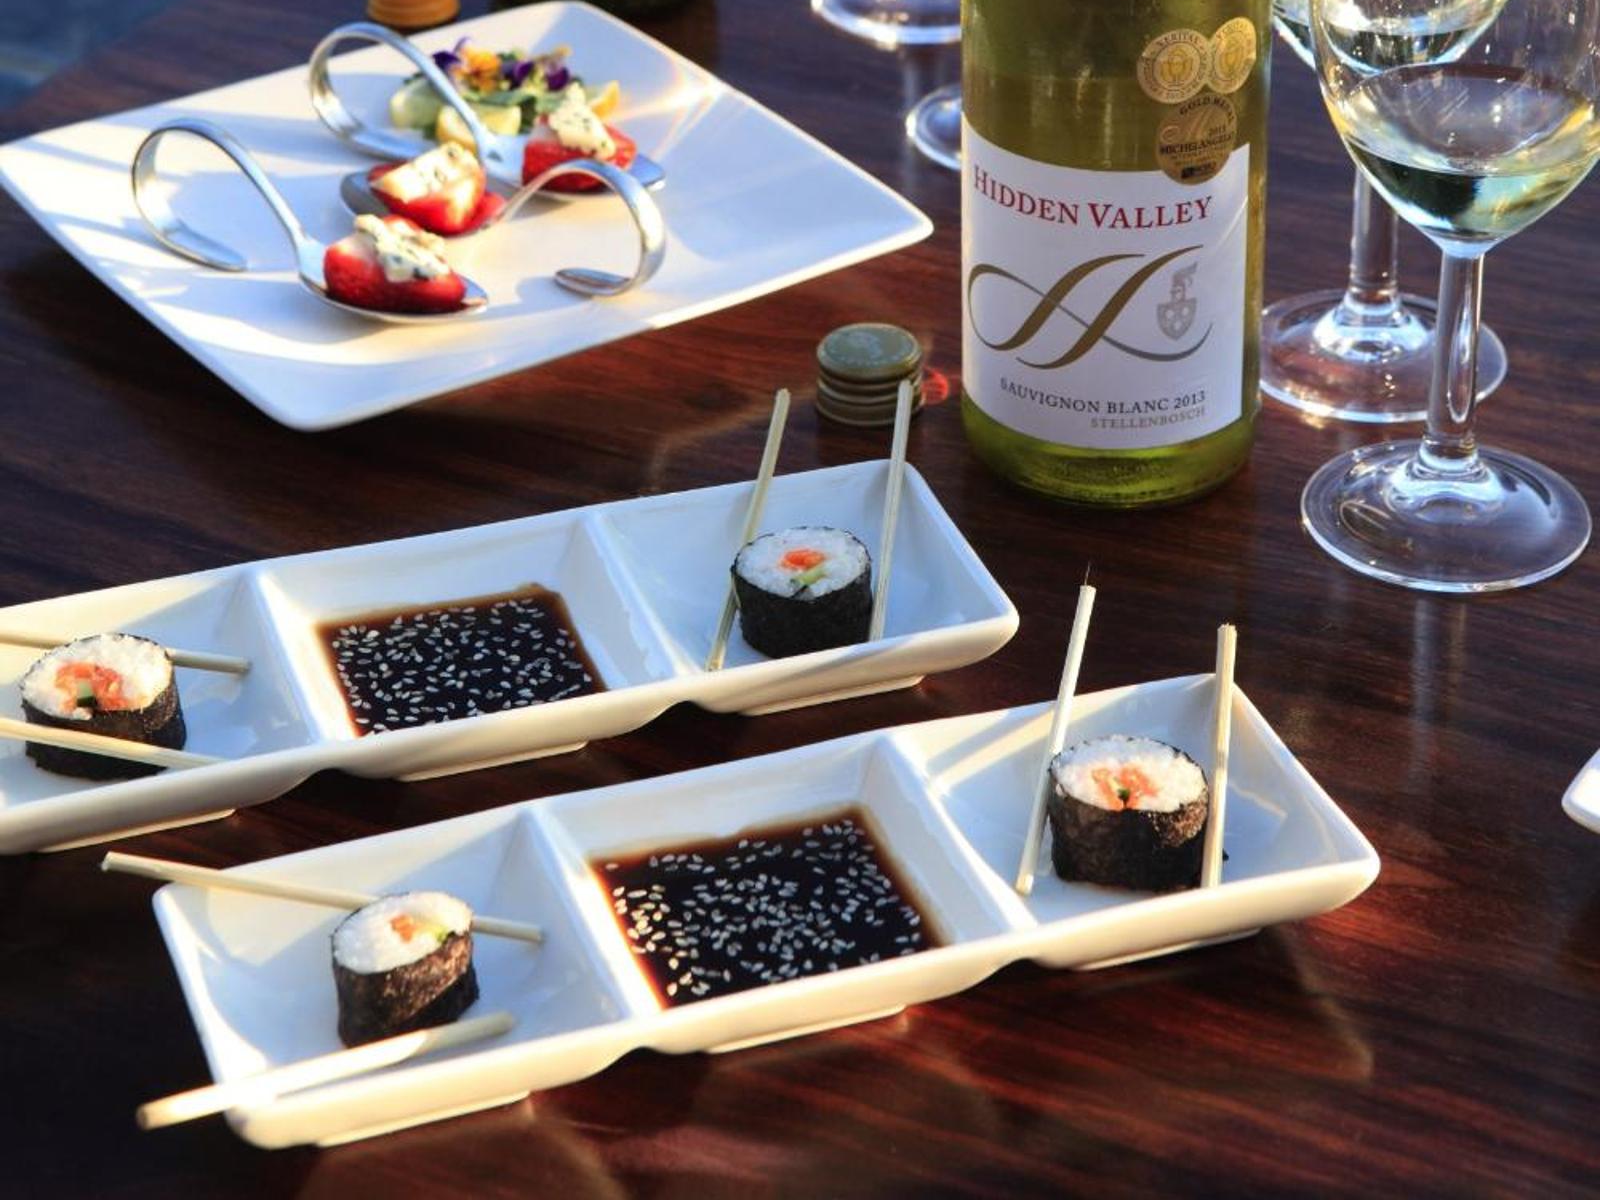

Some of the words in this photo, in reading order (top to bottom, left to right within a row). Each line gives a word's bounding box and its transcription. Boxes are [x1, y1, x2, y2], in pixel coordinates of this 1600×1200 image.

[973, 164, 1079, 226] HIDDEN
[1087, 195, 1212, 230] VALLEY
[1000, 377, 1100, 414] SAUVIGNON
[1107, 399, 1169, 415] BLANC
[1173, 389, 1206, 410] 2013
[1090, 407, 1206, 430] STELLENBOSCH
